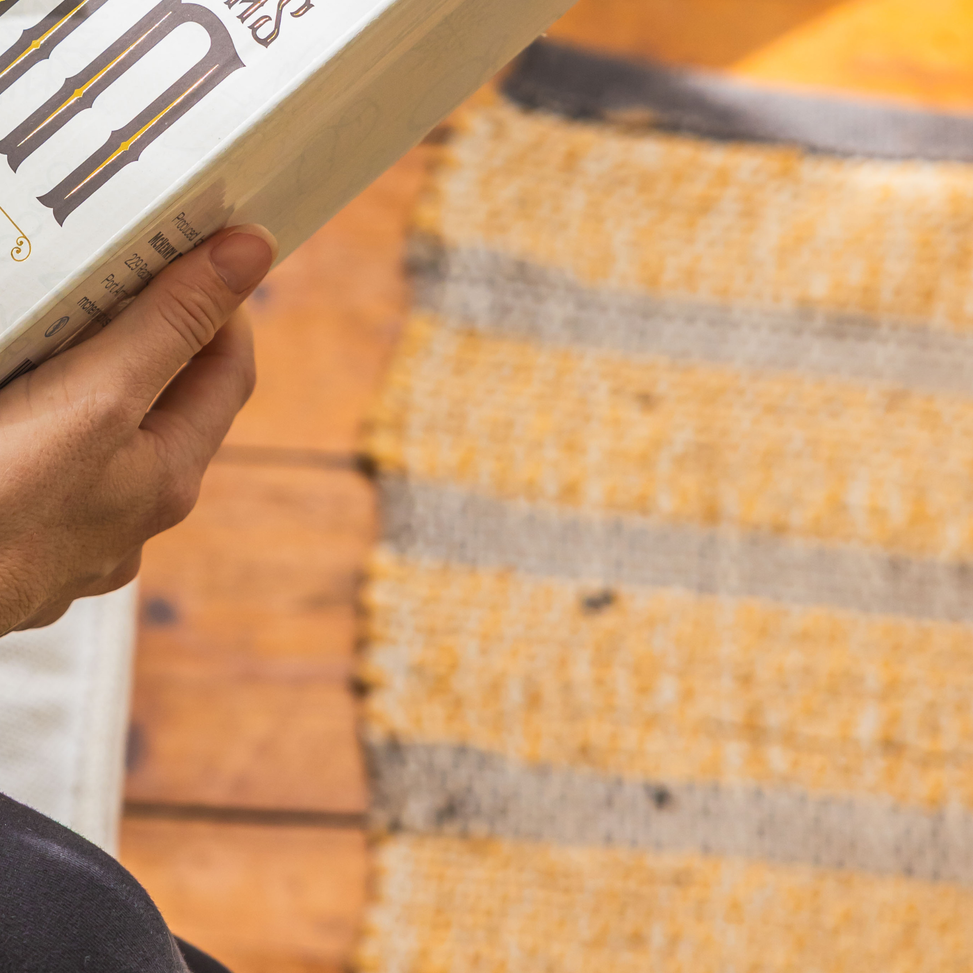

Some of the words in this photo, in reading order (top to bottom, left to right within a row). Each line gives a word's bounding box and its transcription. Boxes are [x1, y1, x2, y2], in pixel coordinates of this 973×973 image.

[171, 212, 202, 241] Produced
[124, 253, 144, 271] 229
[101, 273, 122, 293] Port
